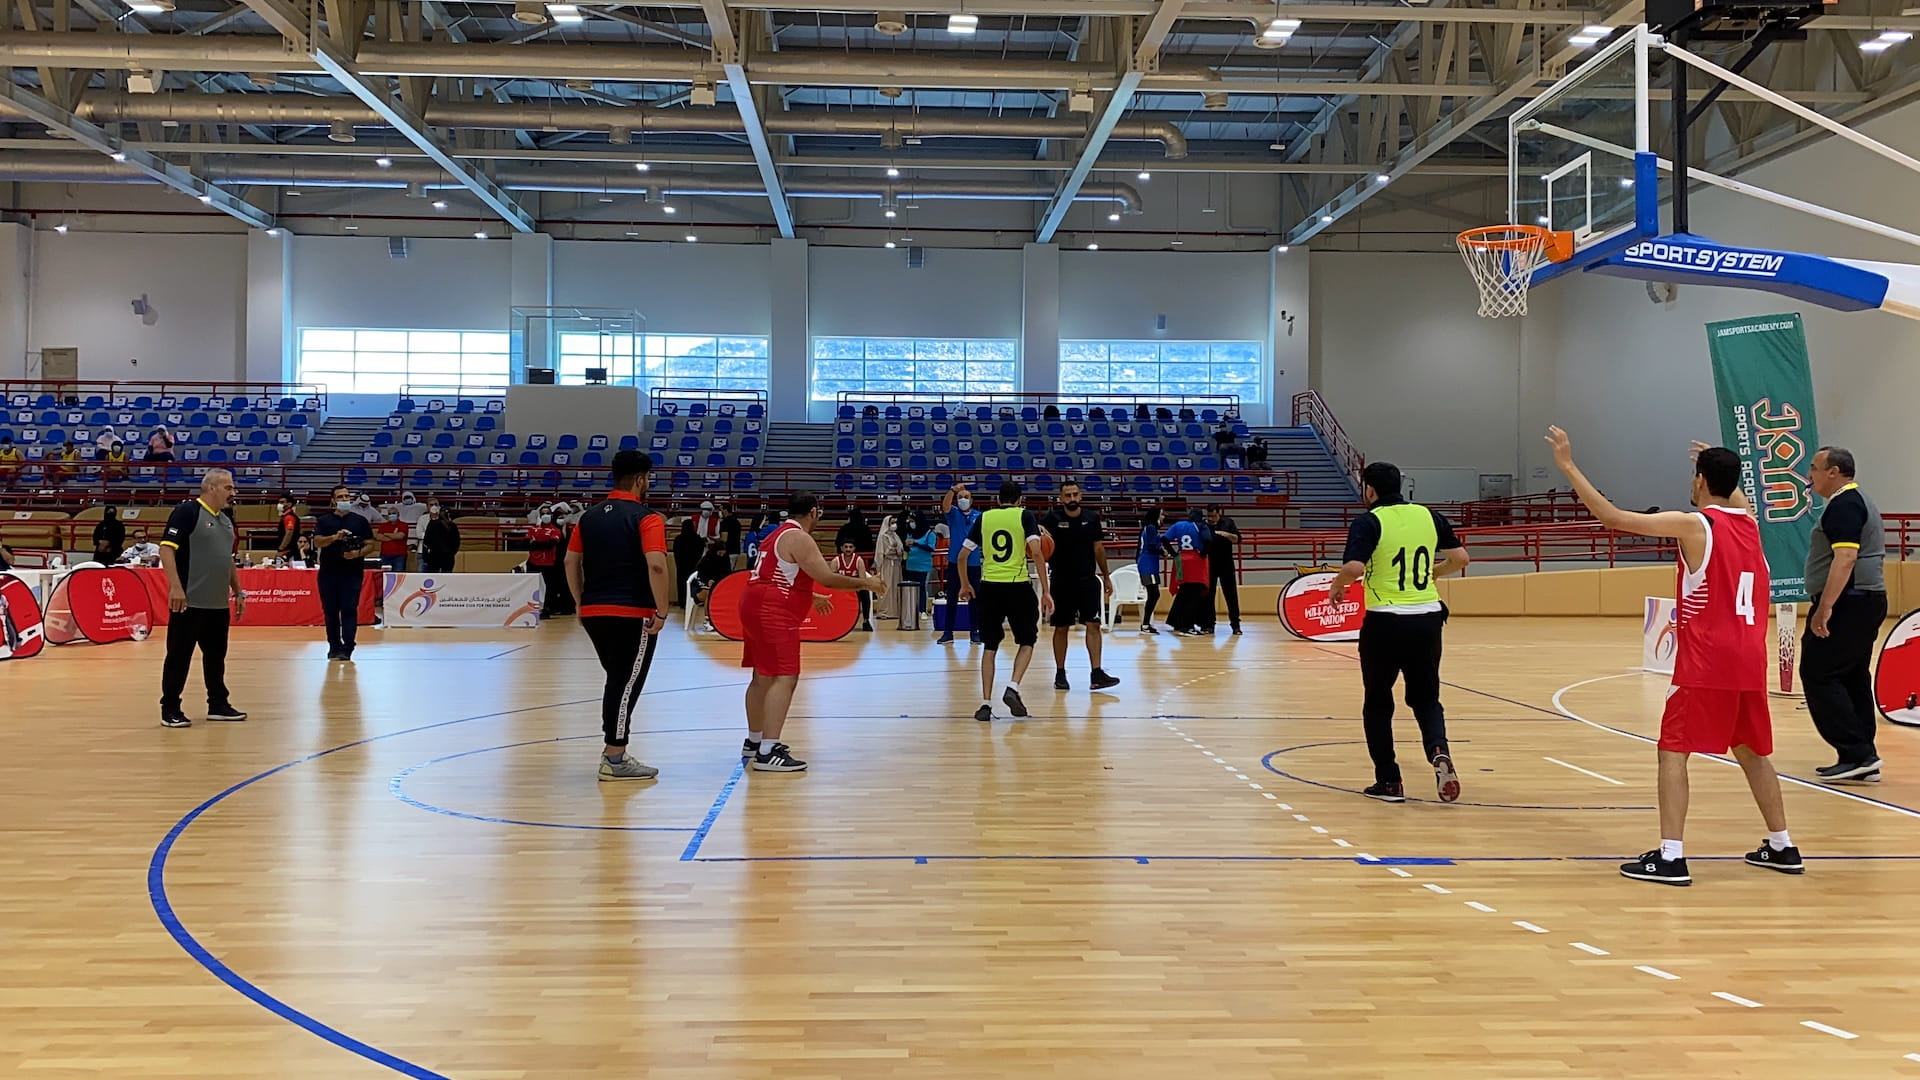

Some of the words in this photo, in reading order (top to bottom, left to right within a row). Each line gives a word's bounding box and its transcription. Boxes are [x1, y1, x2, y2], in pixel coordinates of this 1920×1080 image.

[1717, 321, 1793, 337] JAMSPORTSACADEMY.COM
[1733, 405, 1751, 456] SPORTS
[748, 543, 757, 558] 6
[991, 529, 1013, 563] 9
[1391, 545, 1430, 591] 10
[273, 589, 311, 597] Olympics
[1735, 571, 1755, 625] 4
[1320, 613, 1346, 627] NATION
